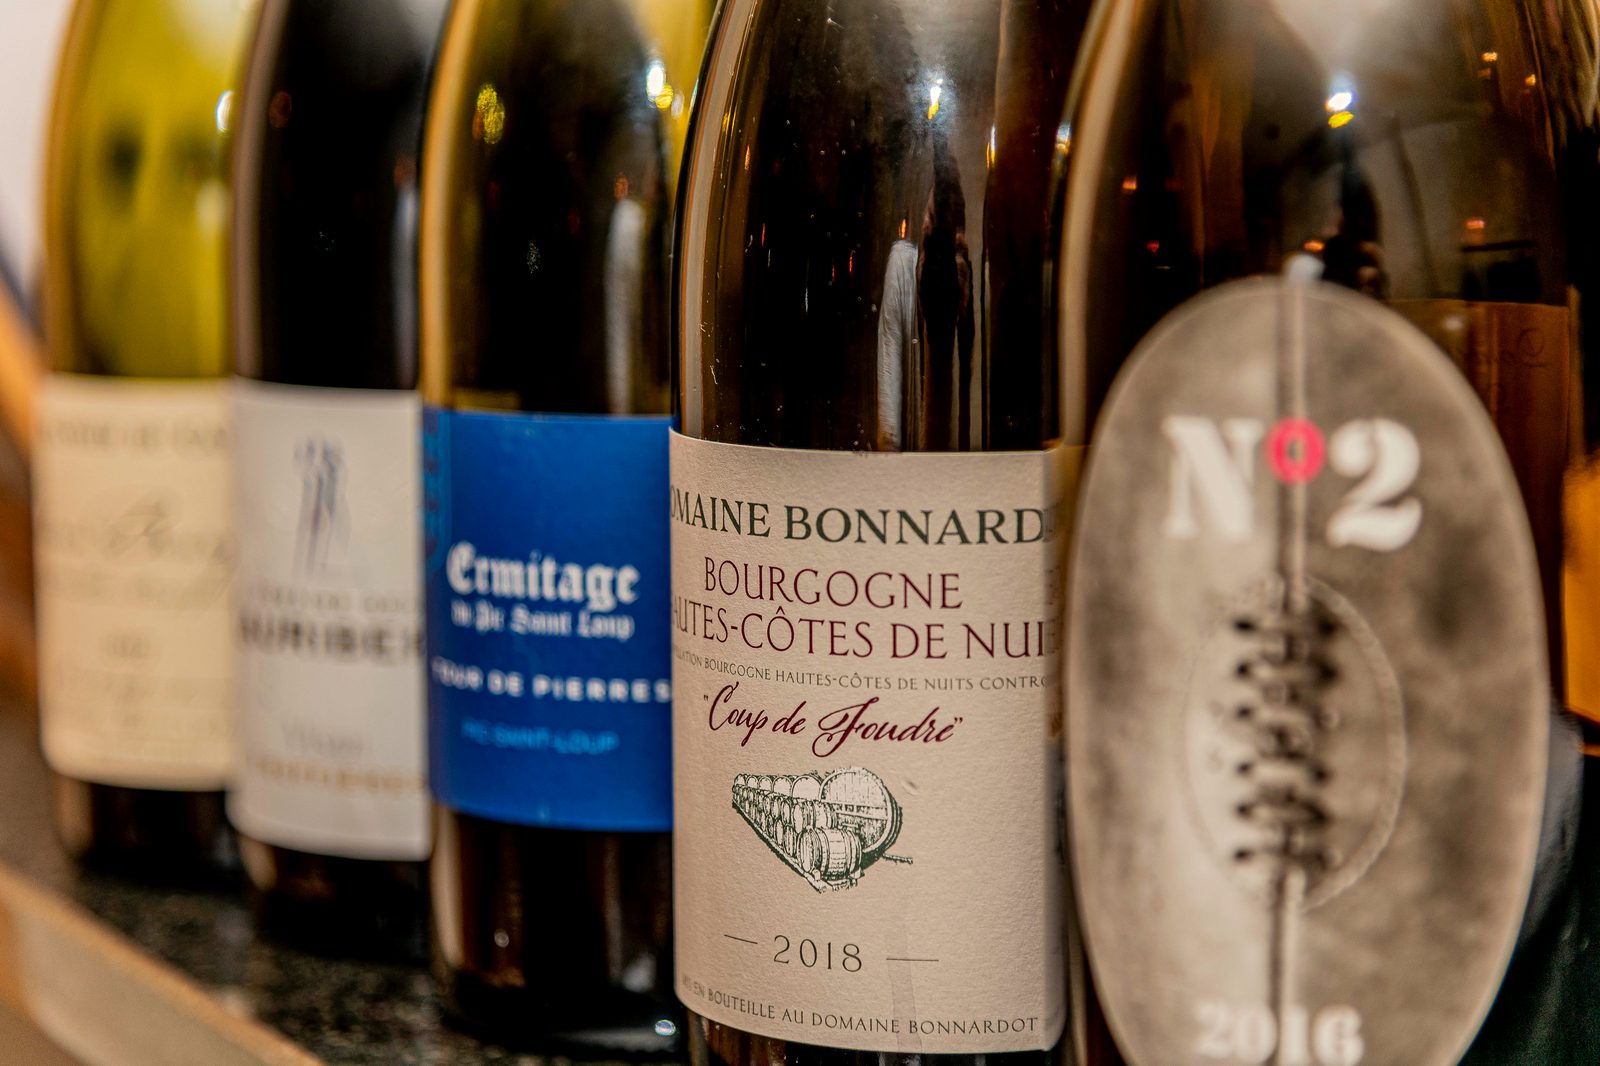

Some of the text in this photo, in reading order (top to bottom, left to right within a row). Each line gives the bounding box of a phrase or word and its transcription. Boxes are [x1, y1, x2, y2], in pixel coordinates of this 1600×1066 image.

[447, 541, 641, 613] Ermitage
[704, 556, 962, 610] BOURGOGNE
[890, 623, 948, 660] DE
[487, 669, 525, 698] DE
[532, 673, 672, 703] PIERRES
[704, 657, 771, 681] BOURGOGNE
[775, 669, 892, 691] HAUTES-CÔTES
[897, 677, 918, 691] DE
[924, 678, 974, 691] NUITS
[761, 700, 807, 735] de
[773, 934, 863, 973] 2018
[708, 988, 776, 1020] BOUTEILLE
[781, 1007, 805, 1025] AU
[811, 1011, 901, 1034] DOMAINE
[908, 1016, 1039, 1035] BONNARDOT
[1193, 1002, 1366, 1066] 2016
